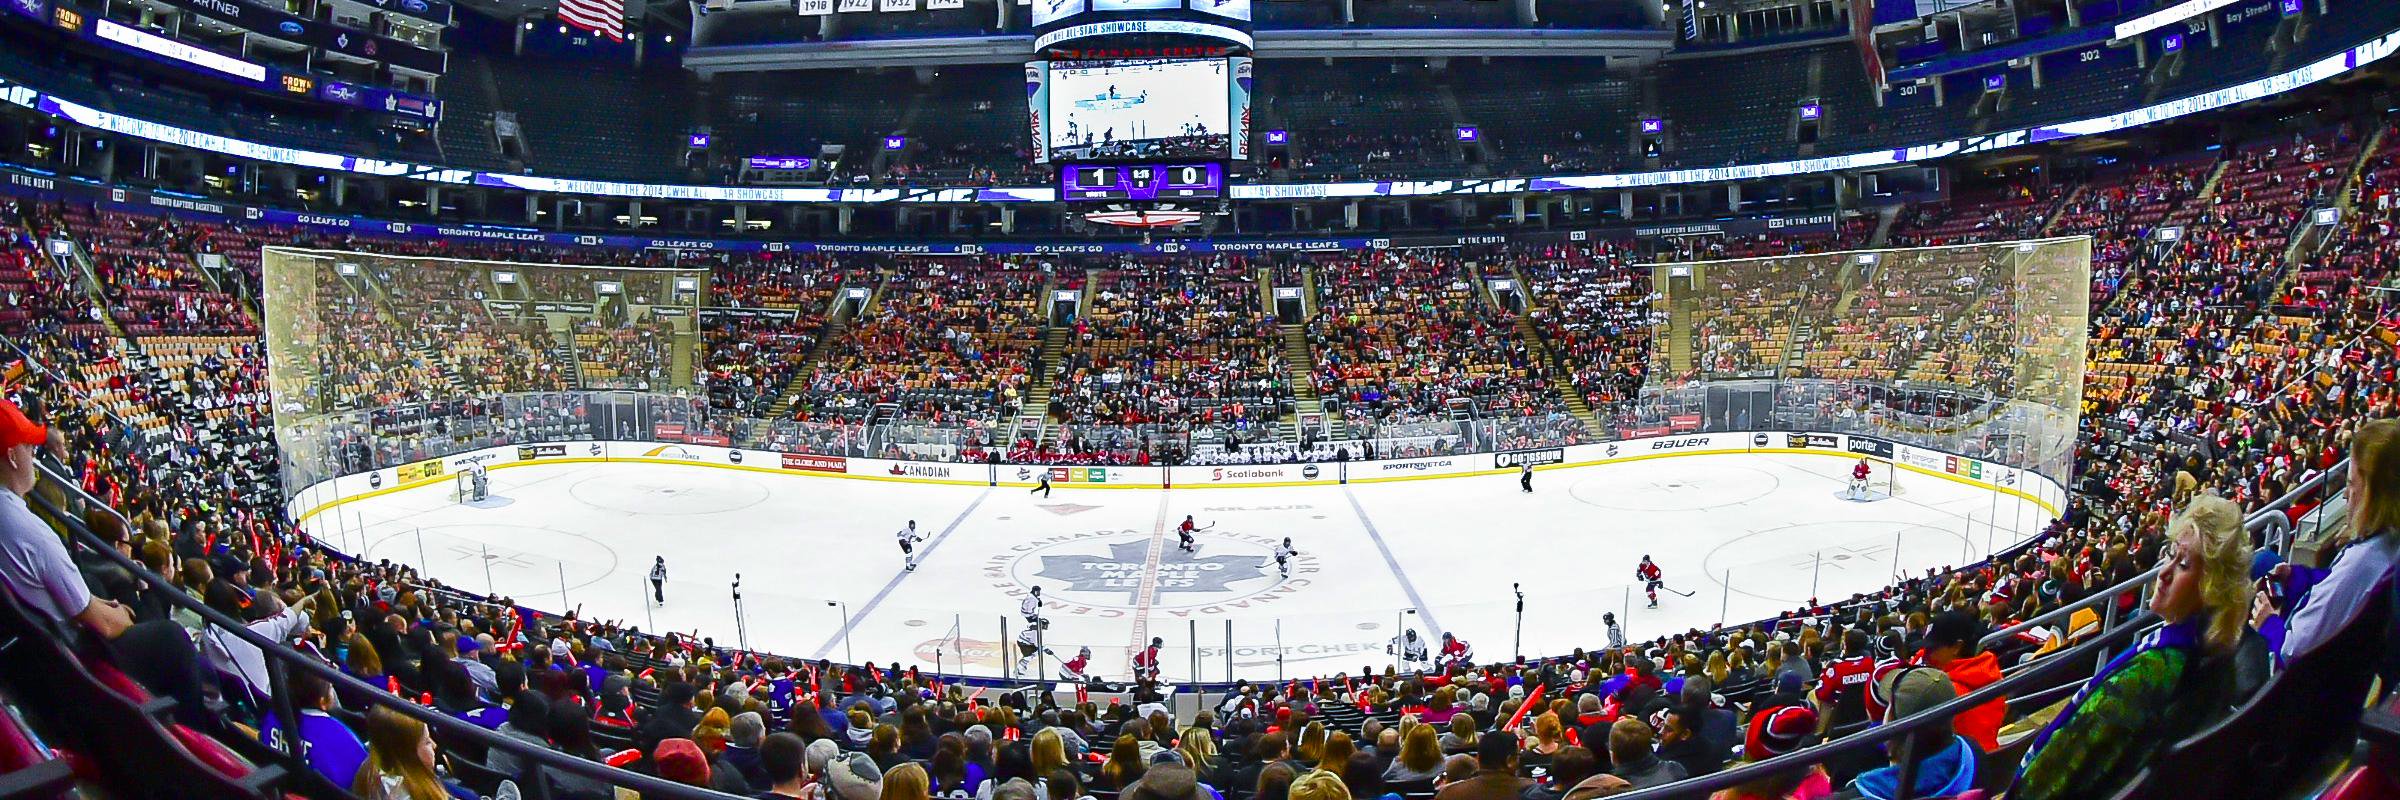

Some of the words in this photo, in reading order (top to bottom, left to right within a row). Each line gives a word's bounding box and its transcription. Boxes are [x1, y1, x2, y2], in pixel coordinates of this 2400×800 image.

[805, 0, 827, 10] 1918
[56, 8, 82, 26] CROWN
[2226, 13, 2242, 26] Bay
[2246, 4, 2272, 18] Street
[1067, 25, 1098, 38] ALL-STAR
[1101, 21, 1147, 33] SHOWCASE
[2189, 22, 2206, 35] 303
[2080, 50, 2100, 62] 302
[282, 75, 312, 88] CROWN
[1900, 86, 1917, 96] 301
[179, 130, 196, 145] 2014
[1182, 167, 1197, 185] 0
[1629, 172, 1671, 185] WELCOME
[1709, 168, 1729, 180] 2014
[1804, 156, 1850, 172] SHOWCASE
[1093, 168, 1104, 186] 1
[567, 181, 607, 193] WELCOME
[643, 185, 663, 195] 2014
[737, 189, 784, 200] SHOWCASE
[1275, 185, 1327, 197] SHOWCASE
[298, 215, 309, 224] GO
[311, 216, 337, 226] LEAFS
[339, 219, 350, 227] GO
[438, 227, 481, 238] TORONTO
[483, 231, 514, 240] MAPLE
[516, 233, 545, 242] LEAFS
[652, 240, 665, 248] GO
[667, 240, 697, 248] LEAFS
[700, 241, 713, 249] GO
[815, 244, 860, 252] TORONTO
[863, 245, 896, 253] MAPLE
[898, 245, 930, 253] LEAFS
[1052, 245, 1085, 253] LEAFS
[1088, 245, 1103, 253] GO
[1213, 242, 1263, 251] TORONTO
[1266, 242, 1302, 250] MAPLE
[1305, 241, 1339, 249] LEAFS
[1652, 437, 1709, 450] BAUER
[1849, 439, 1877, 451] porter
[783, 457, 794, 465] THE
[815, 460, 827, 468] AND
[904, 465, 950, 478] CANADIAN
[1227, 469, 1284, 479] Scotiabank
[1010, 528, 1138, 552] CANADA
[1081, 562, 1225, 572] TORONTO
[1099, 570, 1201, 580] MAPLE
[1103, 579, 1196, 588] LEAFS
